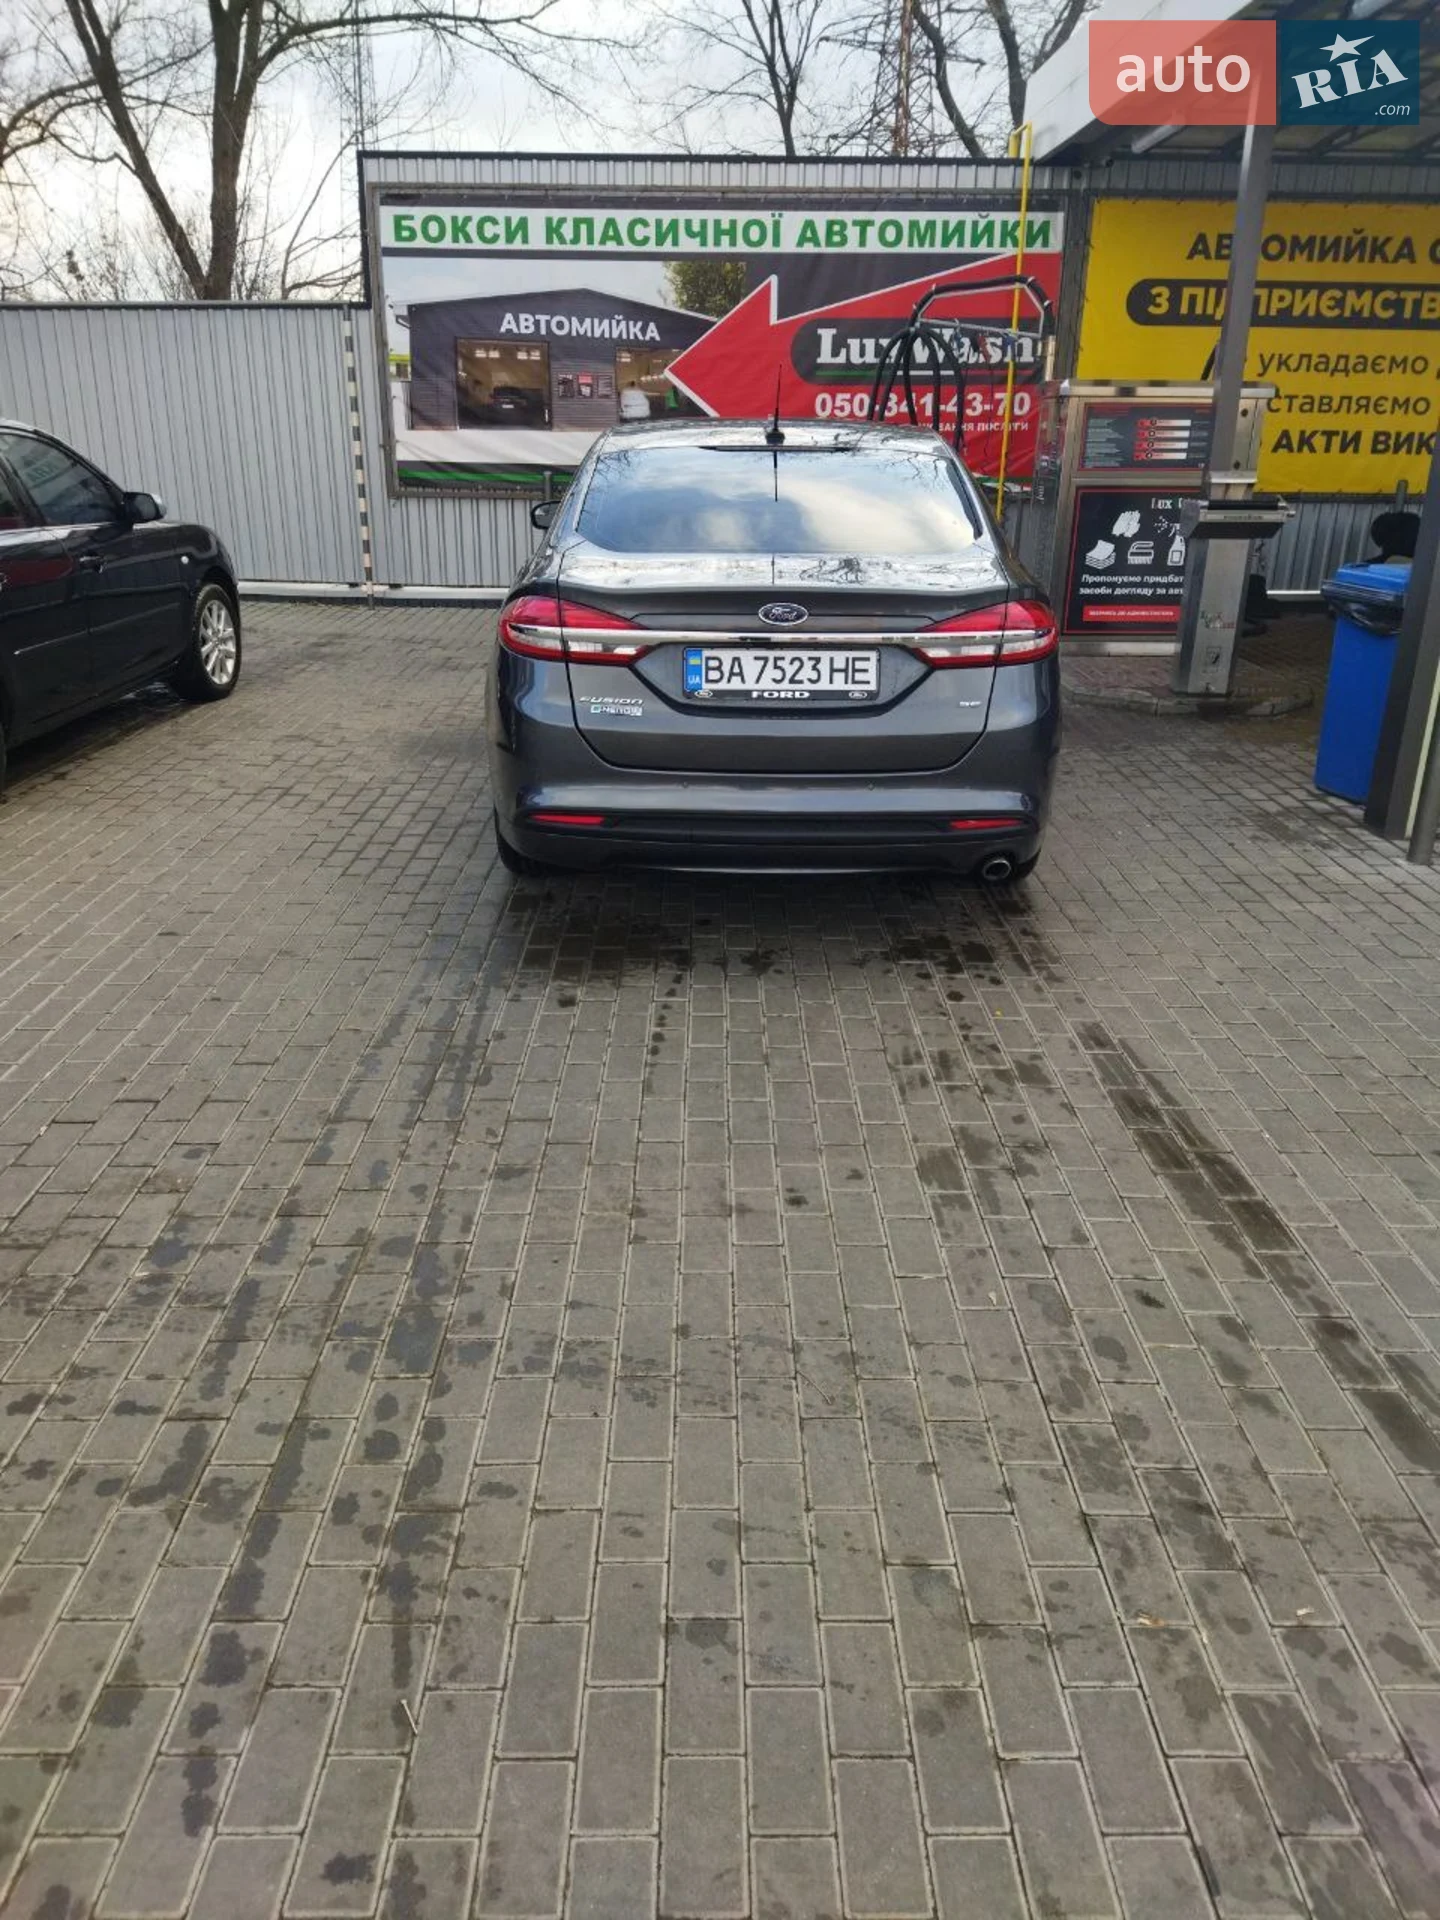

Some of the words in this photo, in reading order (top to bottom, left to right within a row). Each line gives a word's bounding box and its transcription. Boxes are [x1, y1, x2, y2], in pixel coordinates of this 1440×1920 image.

[392, 214, 530, 245] БОКСИ
[544, 212, 783, 248] КЛАСИЧНОЇ
[795, 212, 1051, 248] АВТОМИЙКИ
[1186, 228, 1417, 265] АВОМИЙКА
[500, 312, 661, 342] АВТОМИЙКА
[1257, 352, 1430, 377] укладаємо
[1271, 429, 1362, 455] АКТИ
[704, 656, 747, 685] BA
[753, 656, 823, 685] 7523
[828, 656, 871, 685] HE
[751, 691, 811, 699] FORD
